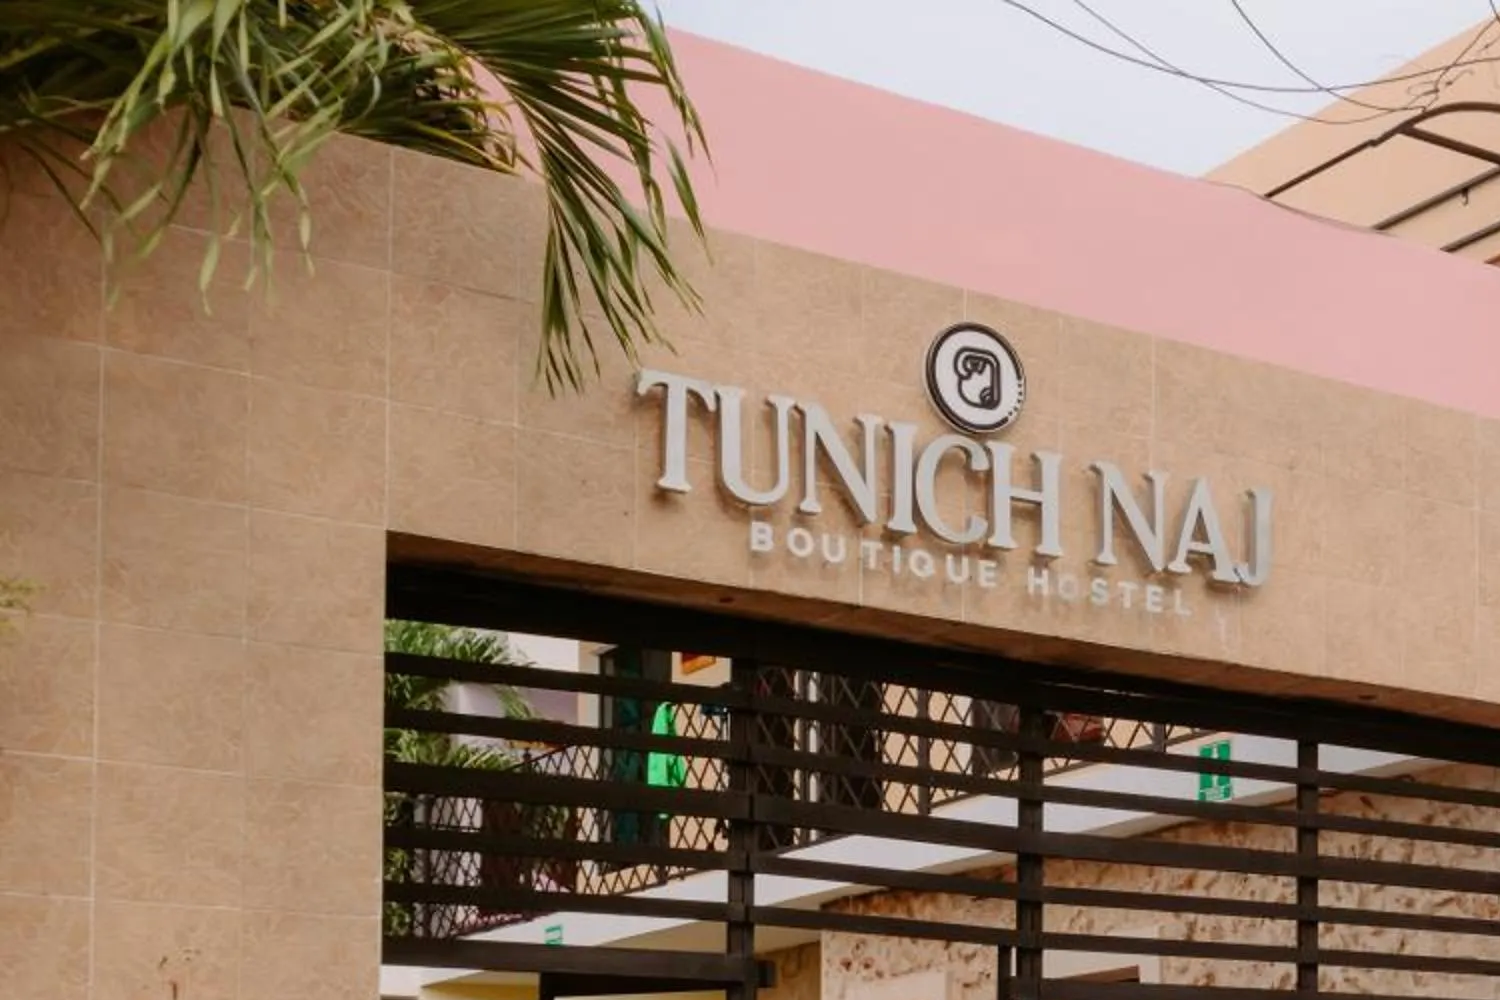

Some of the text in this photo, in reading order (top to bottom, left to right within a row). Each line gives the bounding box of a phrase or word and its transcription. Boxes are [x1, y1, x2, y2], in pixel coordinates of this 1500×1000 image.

[636, 368, 1275, 587] TUNICH NAJ
[750, 520, 1192, 617] BOUTIQUE HOSTEL
